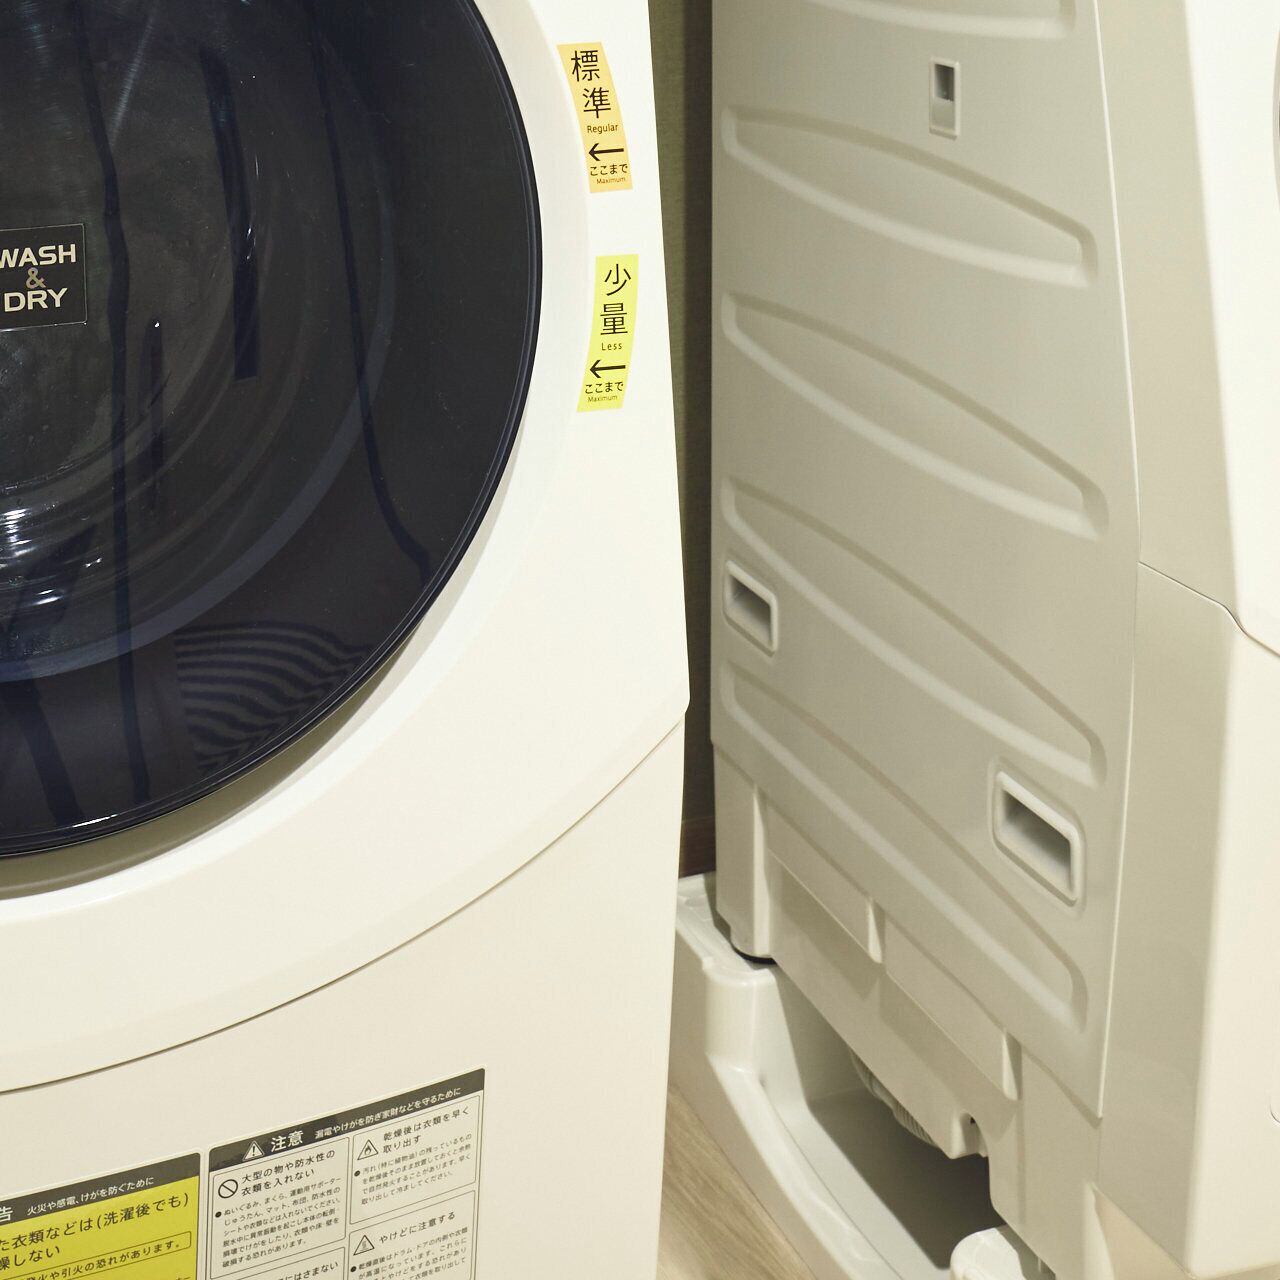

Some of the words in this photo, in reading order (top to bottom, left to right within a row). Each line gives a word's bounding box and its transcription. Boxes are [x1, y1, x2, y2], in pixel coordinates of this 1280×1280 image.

[571, 50, 611, 118] 標準
[587, 123, 618, 134] Regular
[590, 164, 628, 176] ここまで
[26, 267, 46, 288] &
[4, 288, 67, 312] DRY
[601, 263, 631, 336] 少量
[602, 343, 622, 351] Less
[585, 382, 623, 394] ここまで
[588, 395, 617, 403] Maximum
[383, 1106, 469, 1141] 乾燥後は衣類を早く
[271, 1130, 304, 1152] 注意
[383, 1136, 422, 1153] 取り出す
[242, 1149, 335, 1184] 大型の物や防水性の
[242, 1168, 314, 1196] 衣類を入れない
[379, 1211, 455, 1243] やけどに注意する
